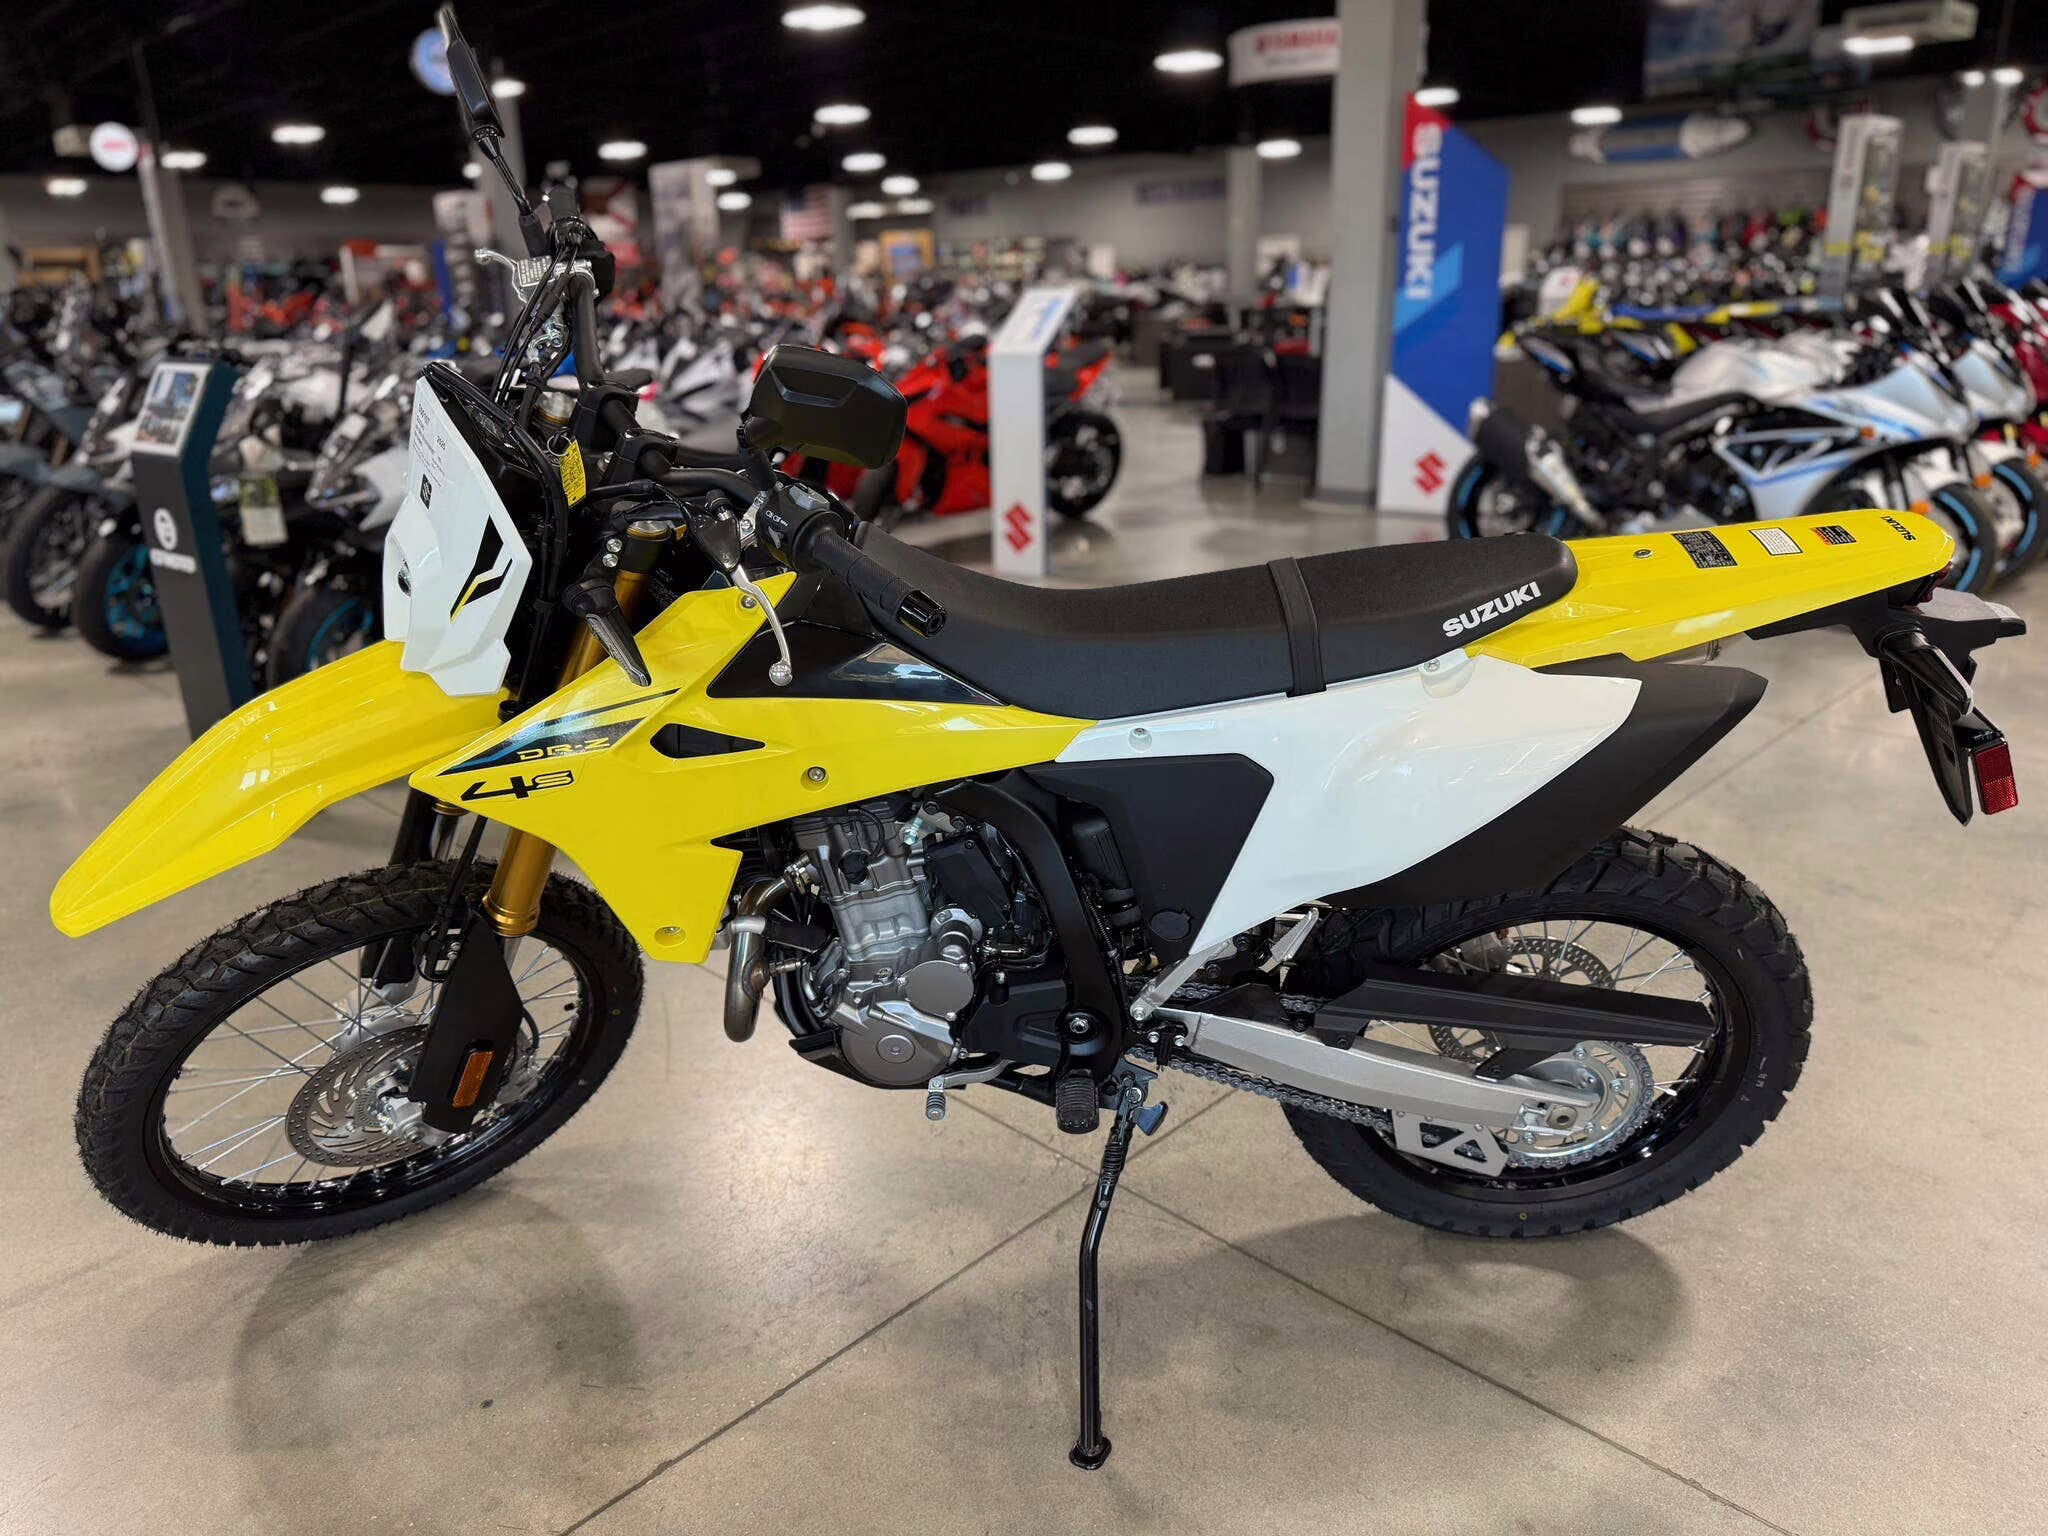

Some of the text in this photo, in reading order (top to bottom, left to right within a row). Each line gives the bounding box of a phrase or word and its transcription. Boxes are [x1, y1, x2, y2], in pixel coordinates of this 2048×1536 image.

[1405, 122, 1442, 299] SUZUKI
[1880, 515, 1916, 541] SUZUKI
[1442, 581, 1541, 637] SUZUKI
[517, 737, 610, 761] DR-Z
[461, 770, 575, 801] 4S
